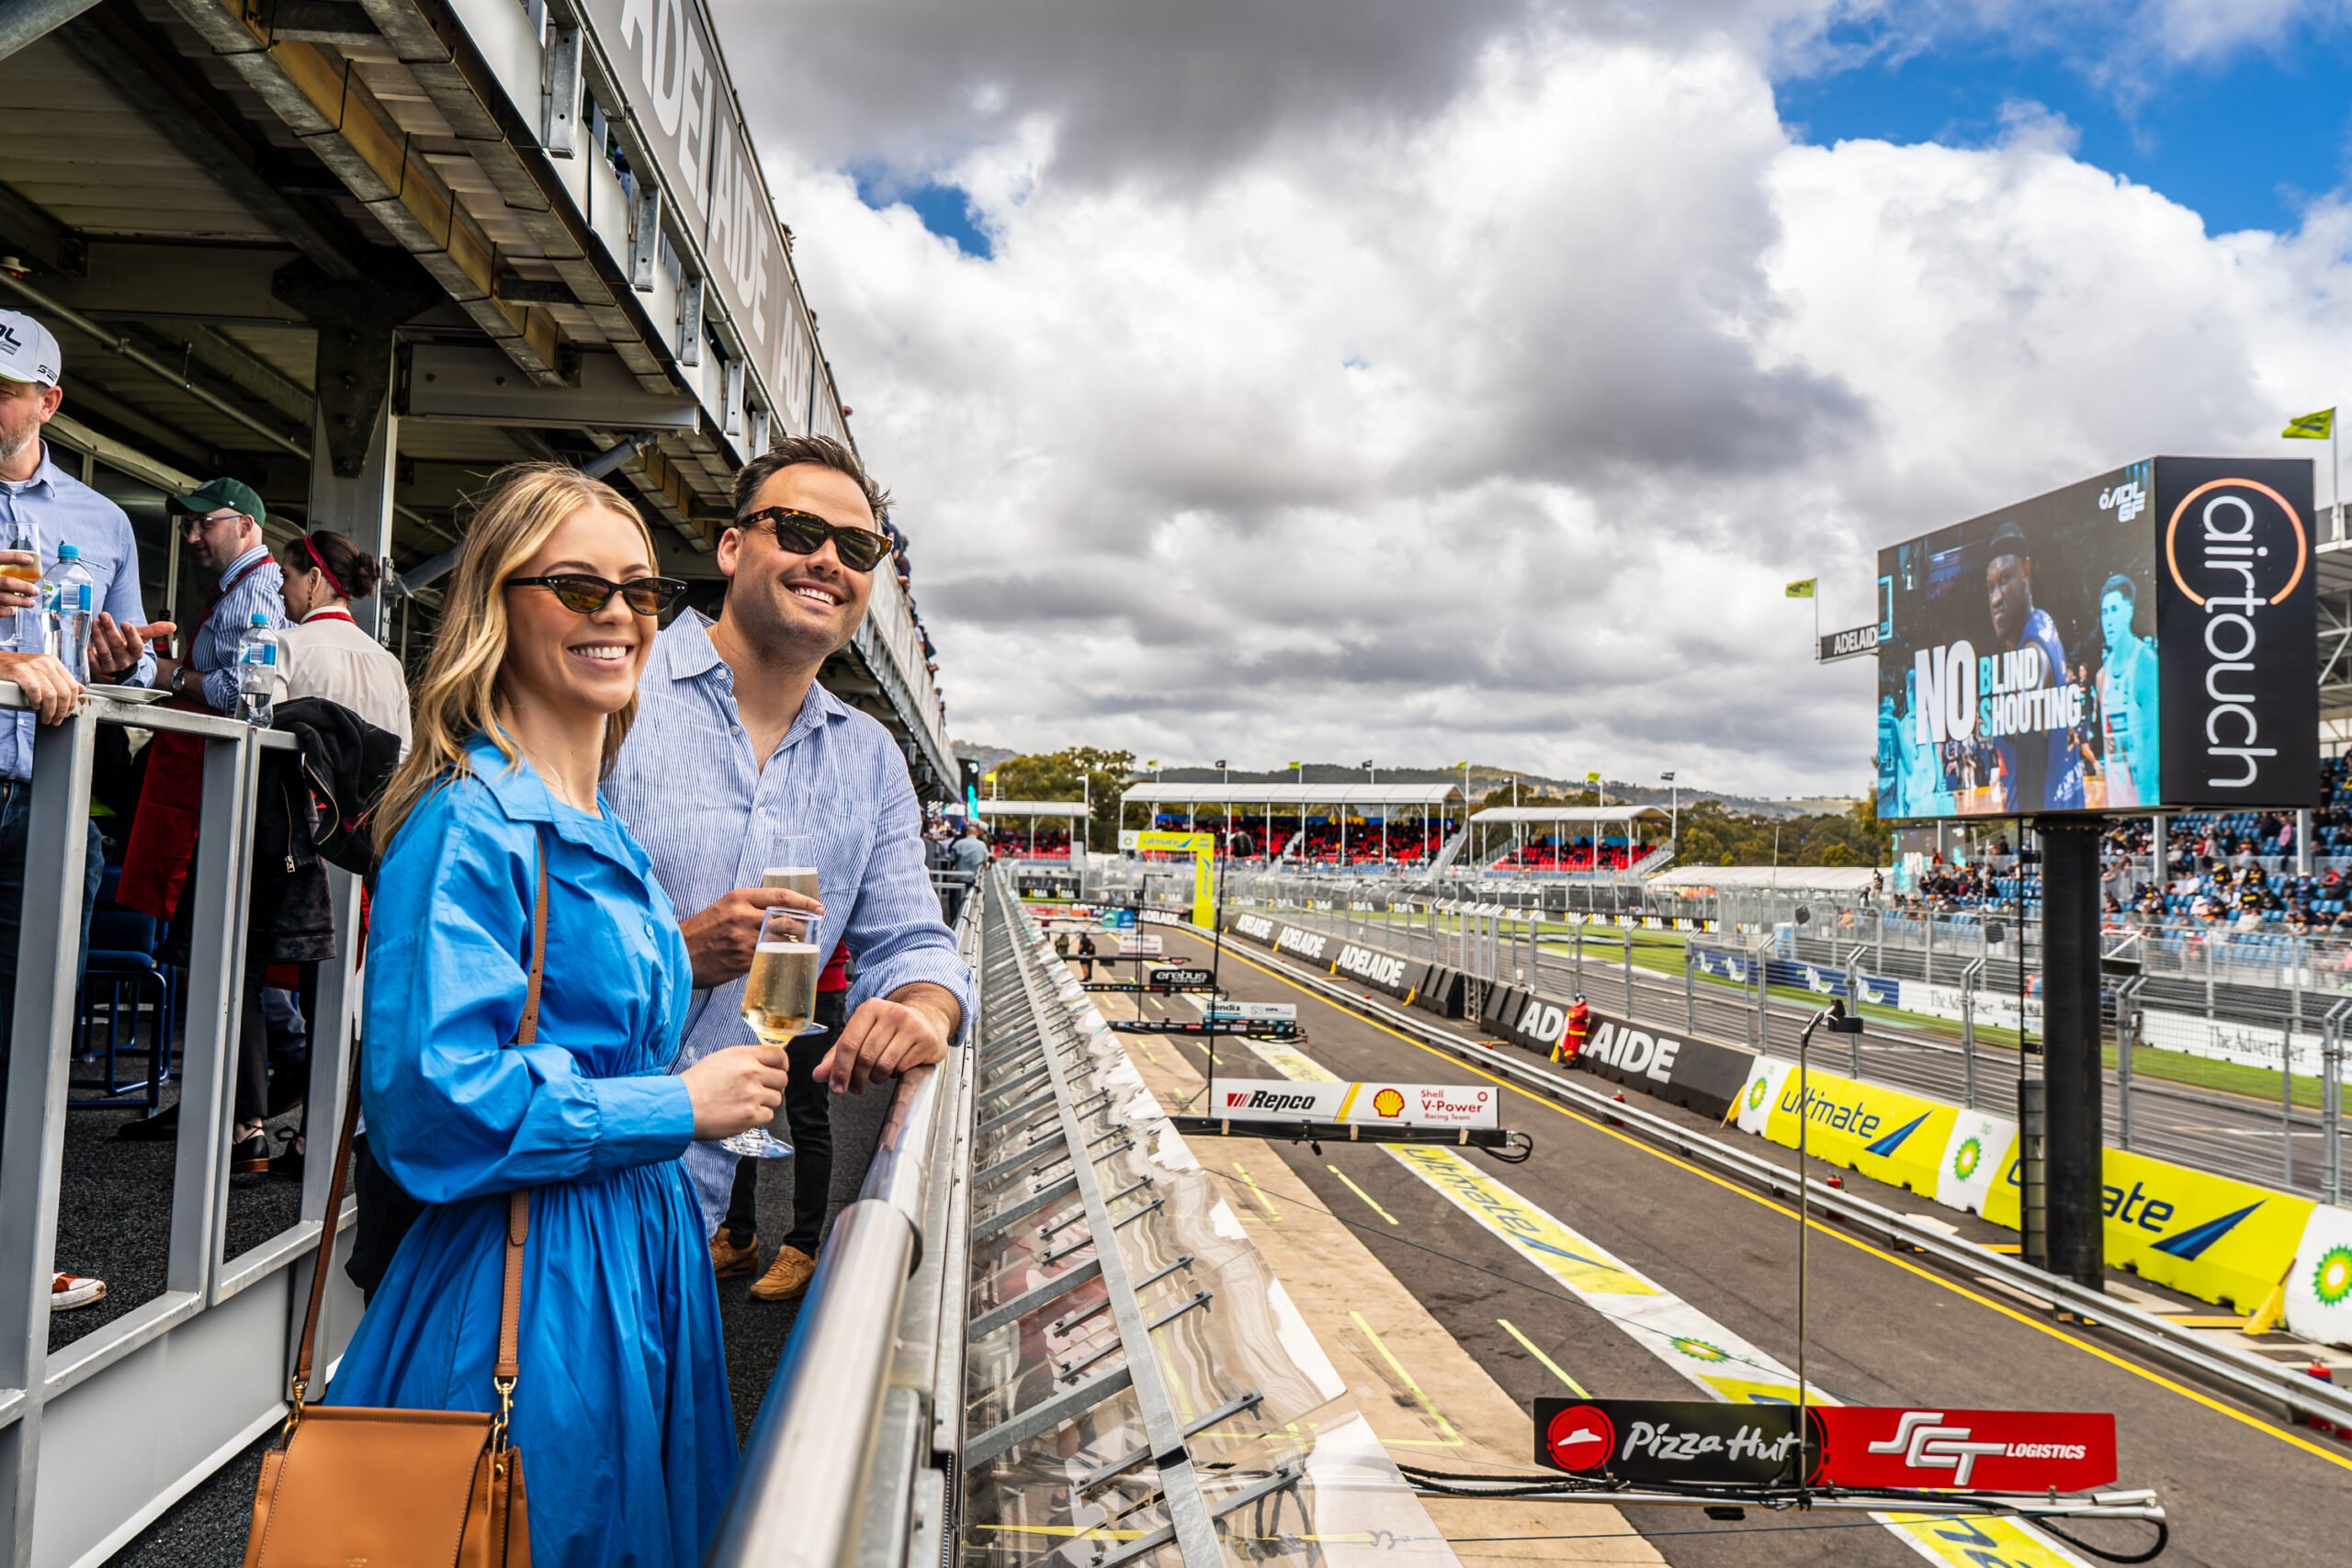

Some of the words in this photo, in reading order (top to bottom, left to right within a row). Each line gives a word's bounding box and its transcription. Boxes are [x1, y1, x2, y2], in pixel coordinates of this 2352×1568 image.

[1833, 626, 1879, 656] ADELAID
[2202, 495, 2278, 787] airtouch
[1979, 647, 2039, 697] BLIND
[1915, 639, 1976, 746] NO
[1979, 683, 2082, 738] SHOUTING
[1352, 901, 1374, 912] RAA
[1393, 903, 1416, 914] RAA
[1592, 913, 1607, 926] RAA
[1235, 913, 1273, 941] ADELAIDE
[1646, 916, 1663, 931] RAA
[1677, 918, 1695, 931] RAA
[1278, 925, 1327, 960] ADELAIDE
[1336, 943, 1406, 988] ADELAIDE
[1248, 1089, 1317, 1112] Repco
[1420, 1089, 1444, 1099] Shell
[1420, 1100, 1483, 1113] V-Power
[1424, 1111, 1448, 1122] Racing
[1451, 1112, 1471, 1122] Team
[1781, 1086, 1881, 1139] ultimate
[1622, 1420, 1724, 1461] Pizza
[1726, 1425, 1802, 1462] Hut
[1867, 1411, 2007, 1486] SCT
[2006, 1442, 2086, 1461] LOGISTICS
